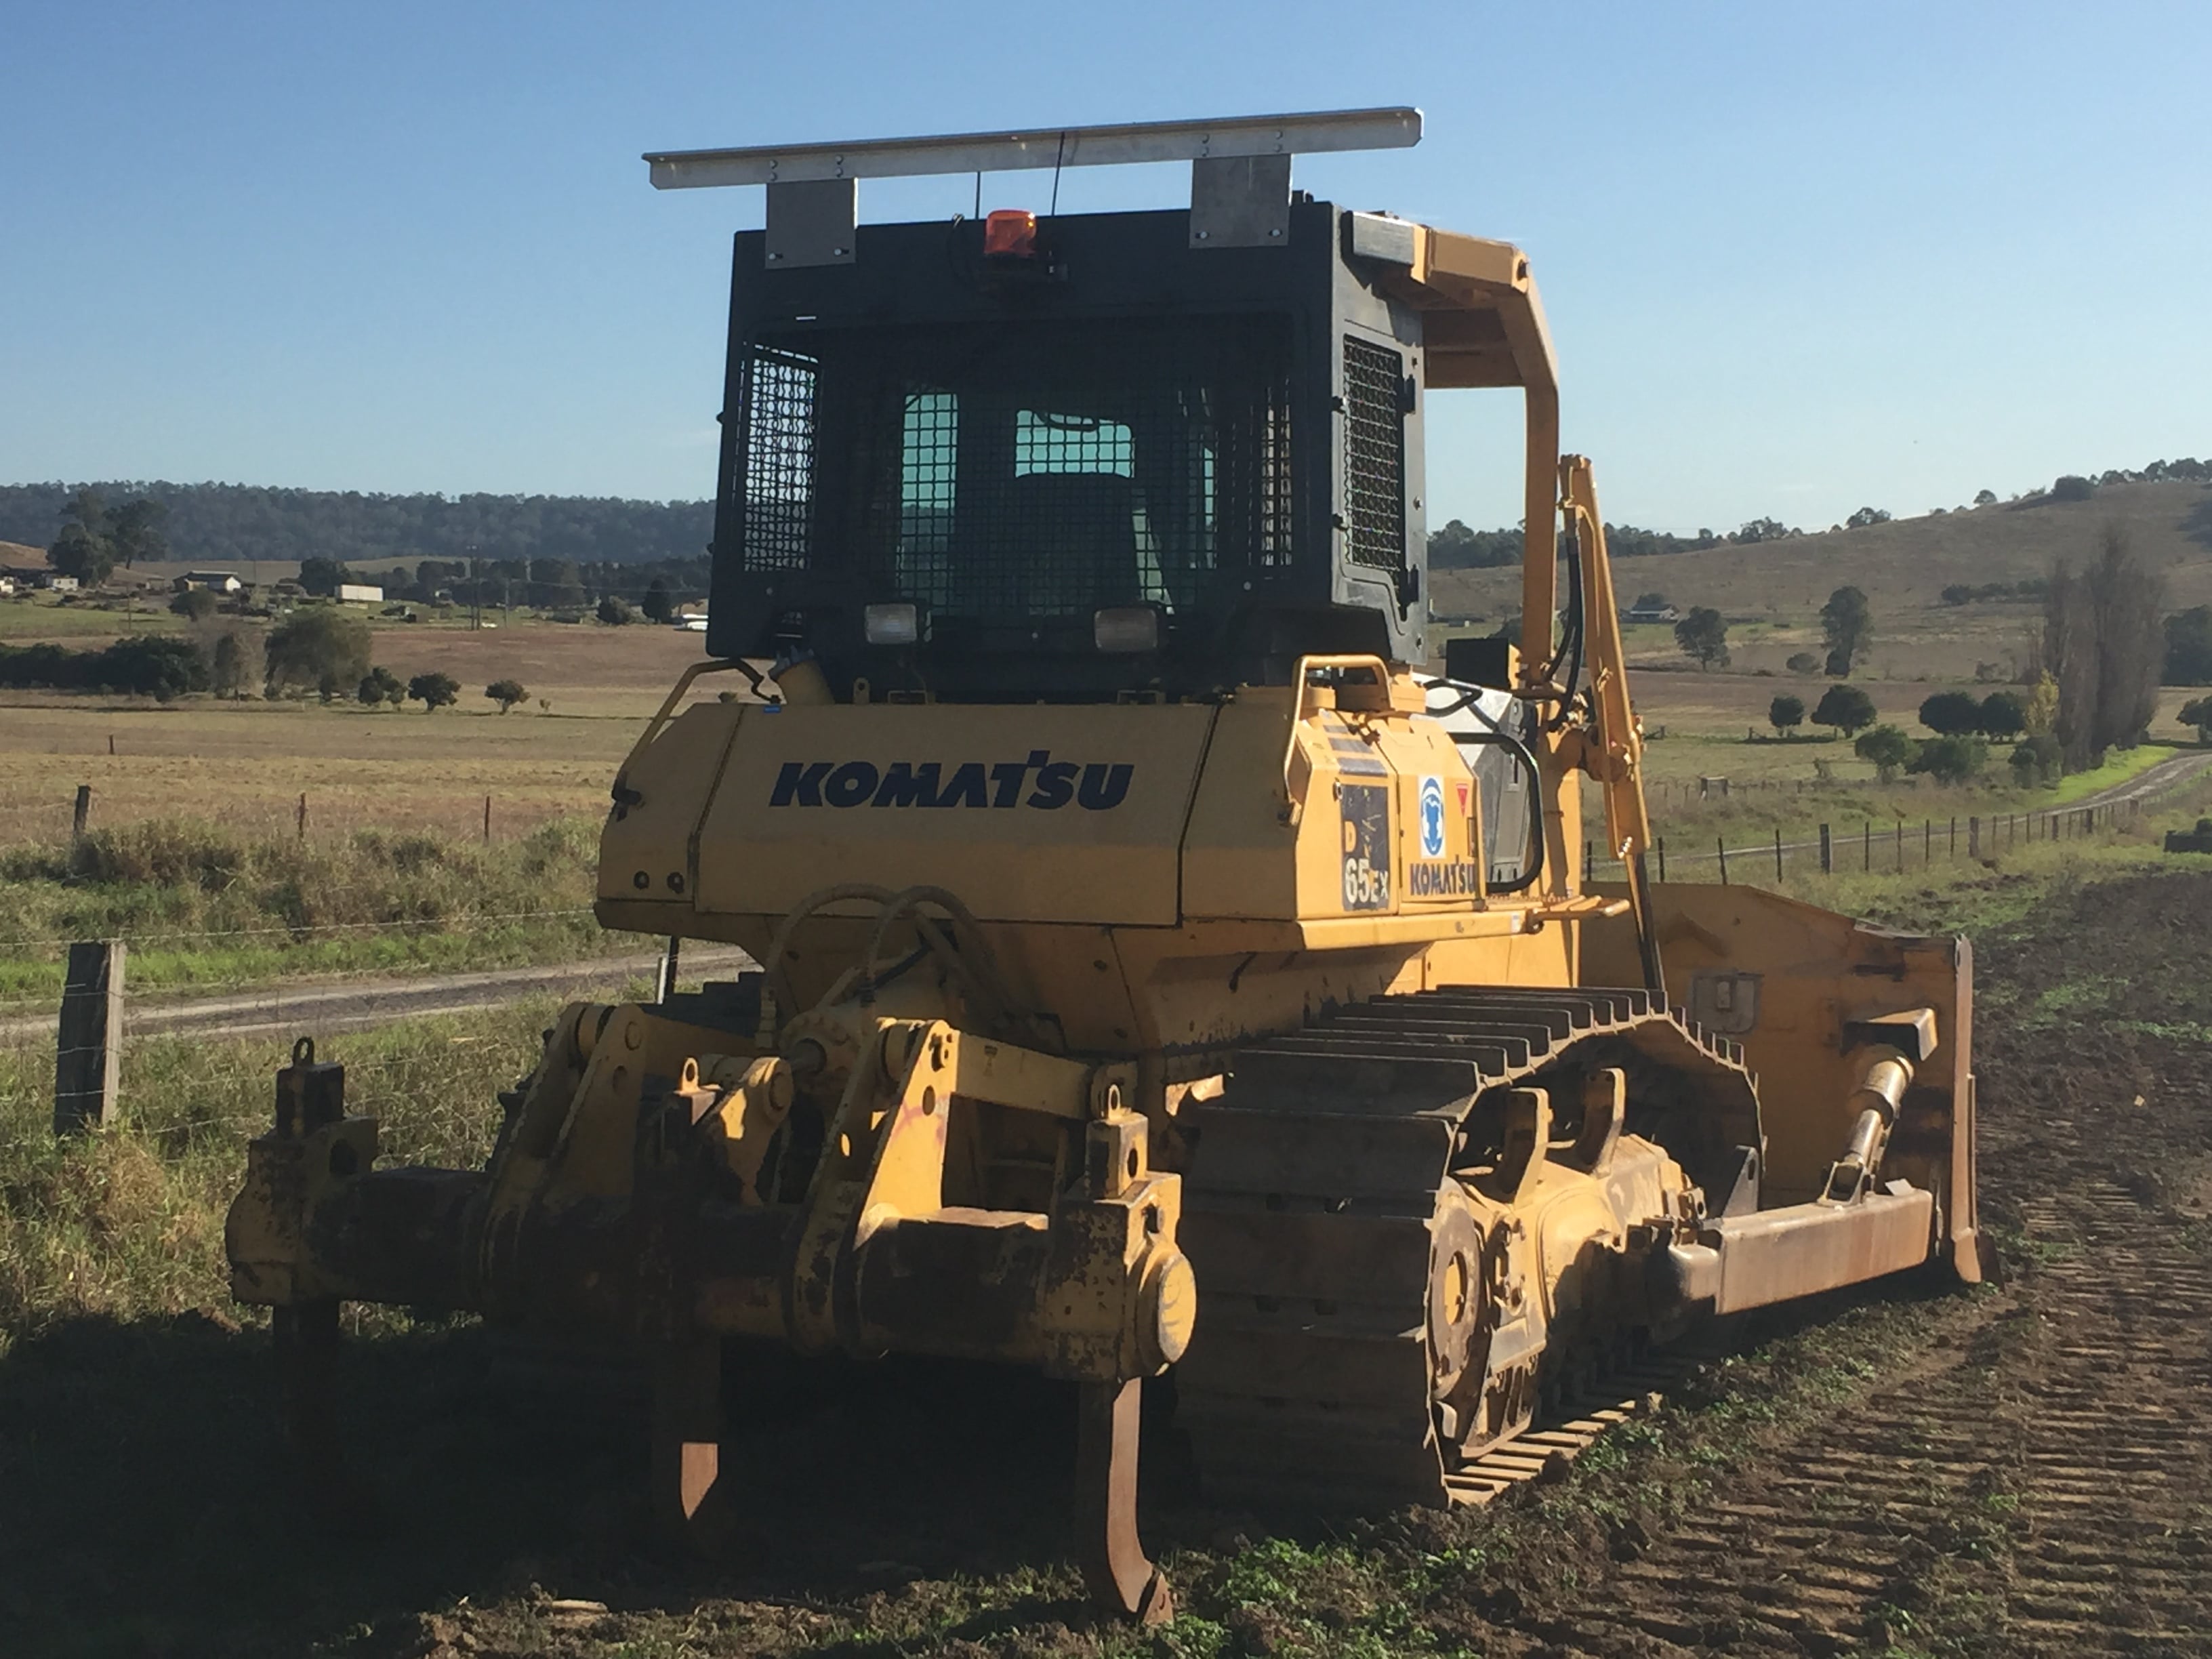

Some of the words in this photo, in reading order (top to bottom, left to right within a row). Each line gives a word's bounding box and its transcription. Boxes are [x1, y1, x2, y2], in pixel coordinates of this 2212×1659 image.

[769, 750, 1134, 811] KOMATSU
[1344, 820, 1356, 853] D
[1410, 855, 1475, 896] KOMATSU
